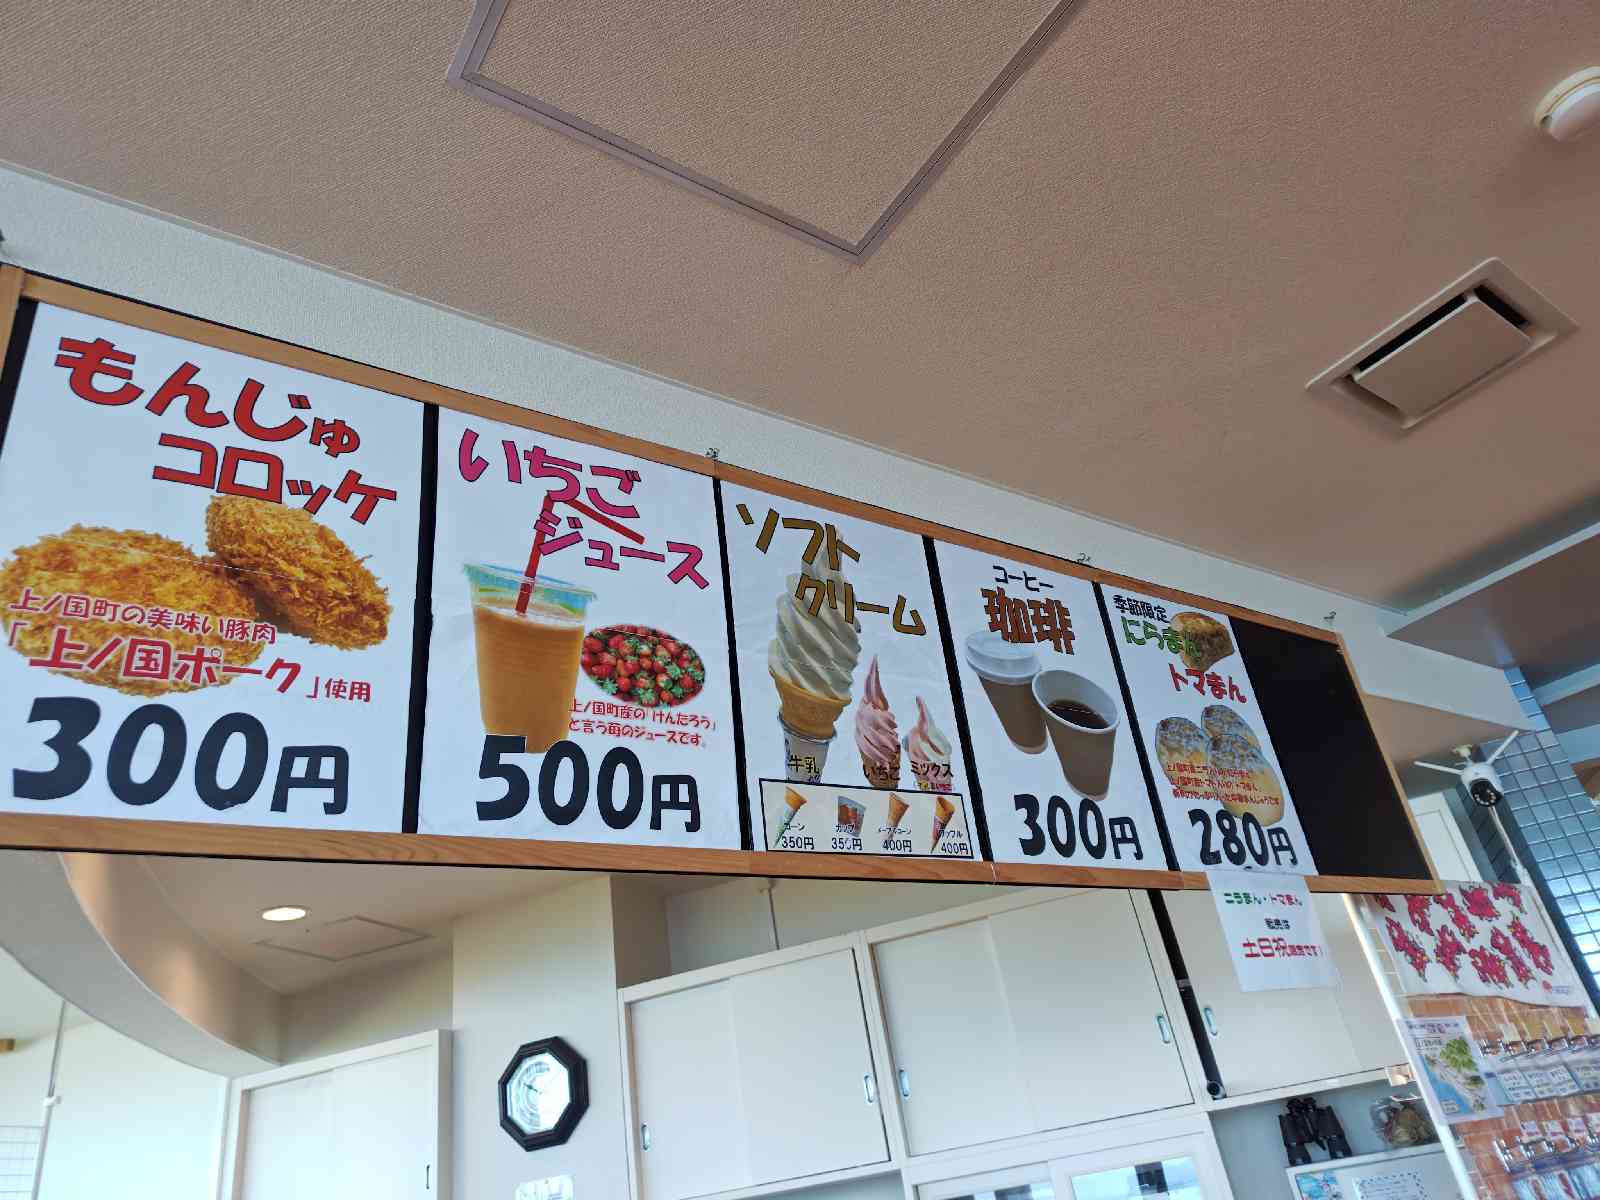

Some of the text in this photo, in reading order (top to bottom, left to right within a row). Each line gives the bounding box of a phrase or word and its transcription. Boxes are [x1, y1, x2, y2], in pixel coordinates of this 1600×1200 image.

[54, 336, 361, 458] もんじゅ
[152, 433, 397, 525] コロッケ
[458, 428, 641, 519] いちご
[533, 511, 710, 590] ジュース
[736, 503, 861, 572] ソフト
[795, 573, 927, 636] クリーム
[993, 565, 1054, 592] コーヒー
[10, 588, 277, 645] 上ノ国町の美味い豚肉
[980, 586, 1076, 656] 珈琲
[1113, 594, 1171, 624] 季節限定
[1168, 663, 1247, 704] トマまん
[12, 696, 350, 816] 300円
[476, 734, 700, 833] 500円
[787, 754, 820, 774] 牛乳
[863, 763, 901, 783] いちご
[910, 760, 954, 779] ミックス
[781, 836, 815, 850] 350円
[882, 838, 912, 853] 400円
[940, 842, 969, 855] 400円
[1013, 793, 1144, 861] 300円
[1188, 808, 1299, 867] 280円
